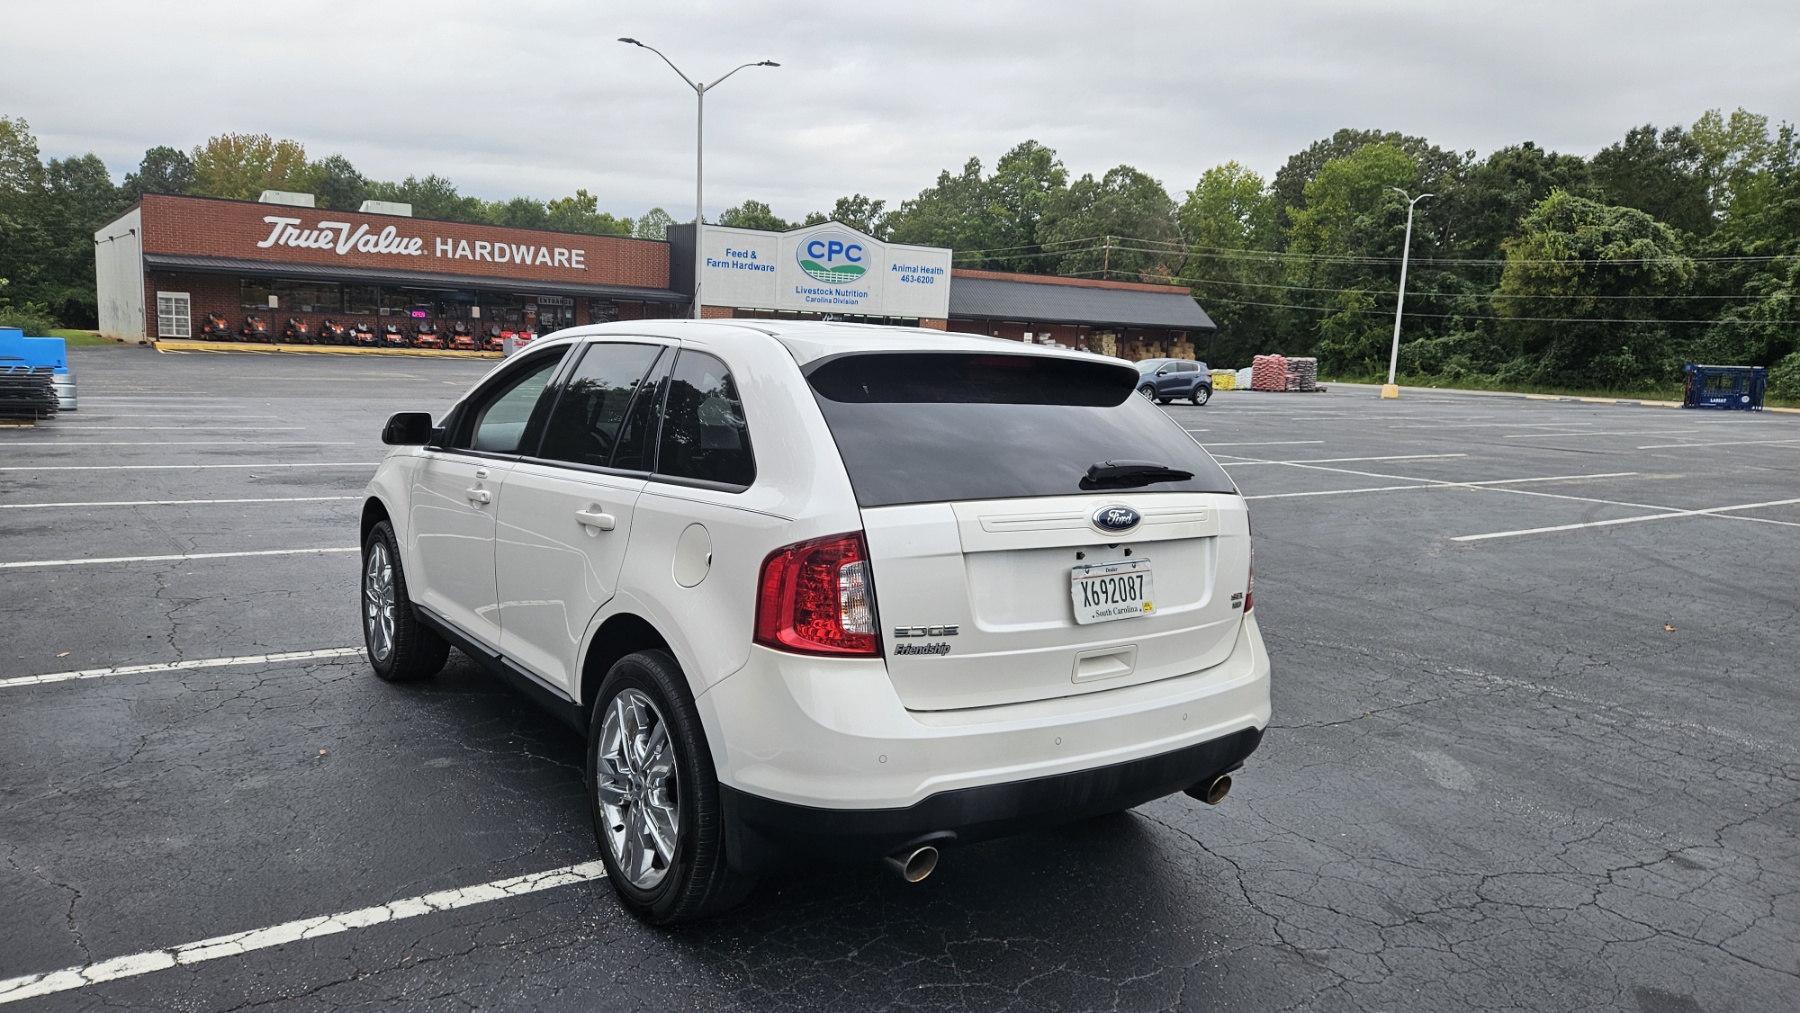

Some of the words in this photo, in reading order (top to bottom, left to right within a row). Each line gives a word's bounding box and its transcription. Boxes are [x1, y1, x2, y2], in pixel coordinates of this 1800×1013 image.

[435, 237, 585, 269] HARDWARE
[725, 248, 749, 259] Feed
[750, 250, 757, 260] &
[807, 240, 863, 263] CPC
[706, 258, 730, 269] Farm
[731, 260, 775, 273] Hardware
[891, 263, 919, 274] Animal
[920, 265, 944, 275] Health
[900, 274, 935, 285] 463-6200
[795, 285, 834, 296] Livestock
[835, 288, 868, 298] Nutrition
[805, 296, 832, 304] Carolina
[833, 297, 859, 305] Division
[1107, 509, 1133, 525] Ford
[1081, 575, 1143, 607] X692087
[1095, 608, 1112, 617] South
[1113, 605, 1138, 615] Carolina
[894, 624, 959, 638] EDGE
[893, 642, 951, 656] Friendship
